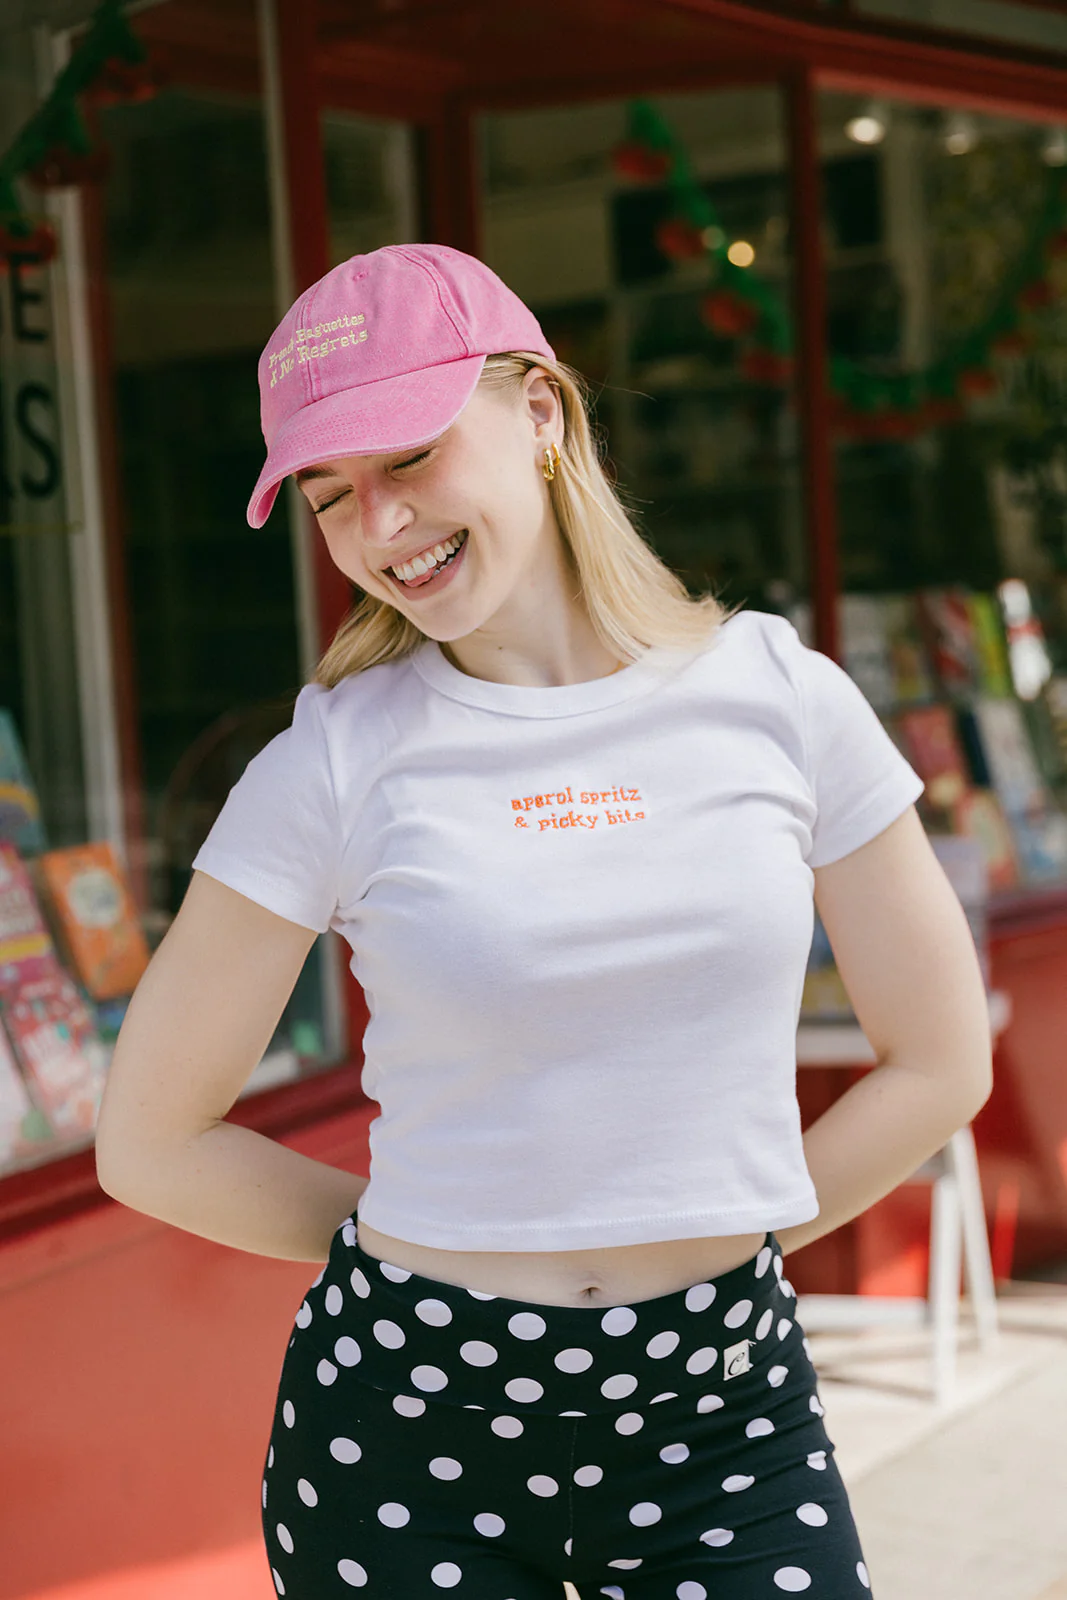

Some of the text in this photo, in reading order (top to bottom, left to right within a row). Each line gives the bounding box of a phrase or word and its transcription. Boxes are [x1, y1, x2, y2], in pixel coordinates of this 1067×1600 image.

[296, 313, 365, 344] Baguettes
[297, 329, 368, 364] Regrets
[511, 785, 642, 812] aperol spritz
[514, 809, 645, 832] & picky bits
